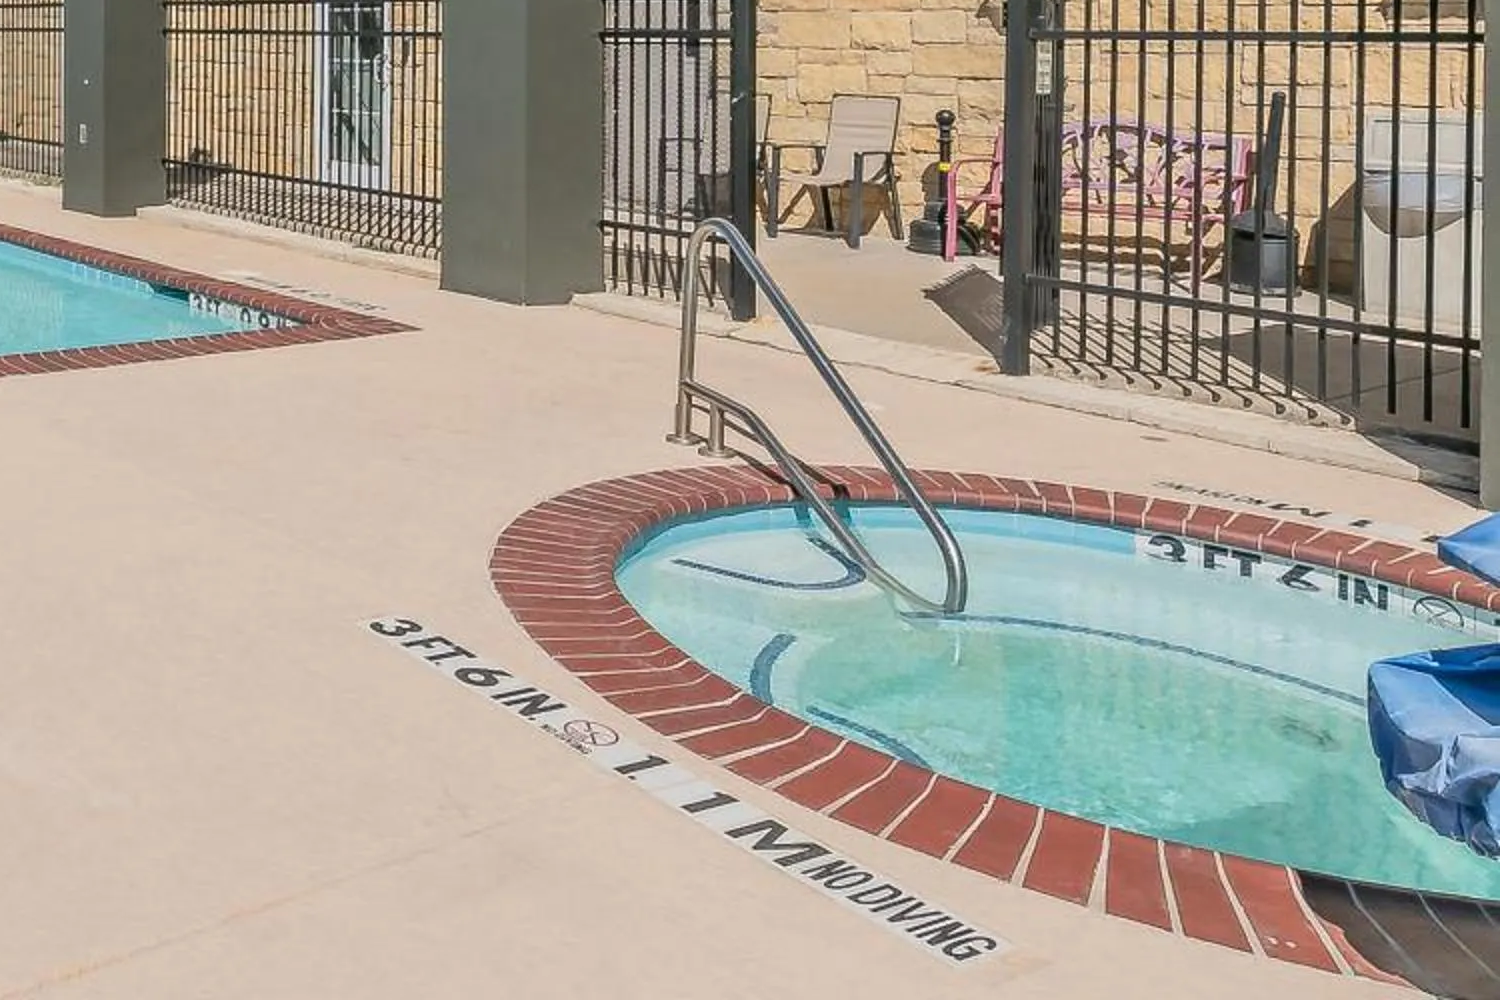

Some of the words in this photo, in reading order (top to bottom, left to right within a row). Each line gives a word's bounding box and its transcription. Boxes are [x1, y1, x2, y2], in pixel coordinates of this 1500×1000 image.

[1148, 535, 1189, 563] 3
[1203, 543, 1262, 577] FT
[1276, 563, 1322, 593] 6
[1337, 573, 1390, 611] IN
[369, 618, 423, 637] 3
[454, 667, 514, 687] 6
[723, 819, 833, 867] M
[801, 859, 875, 889] NO
[846, 883, 998, 961] DIVING
